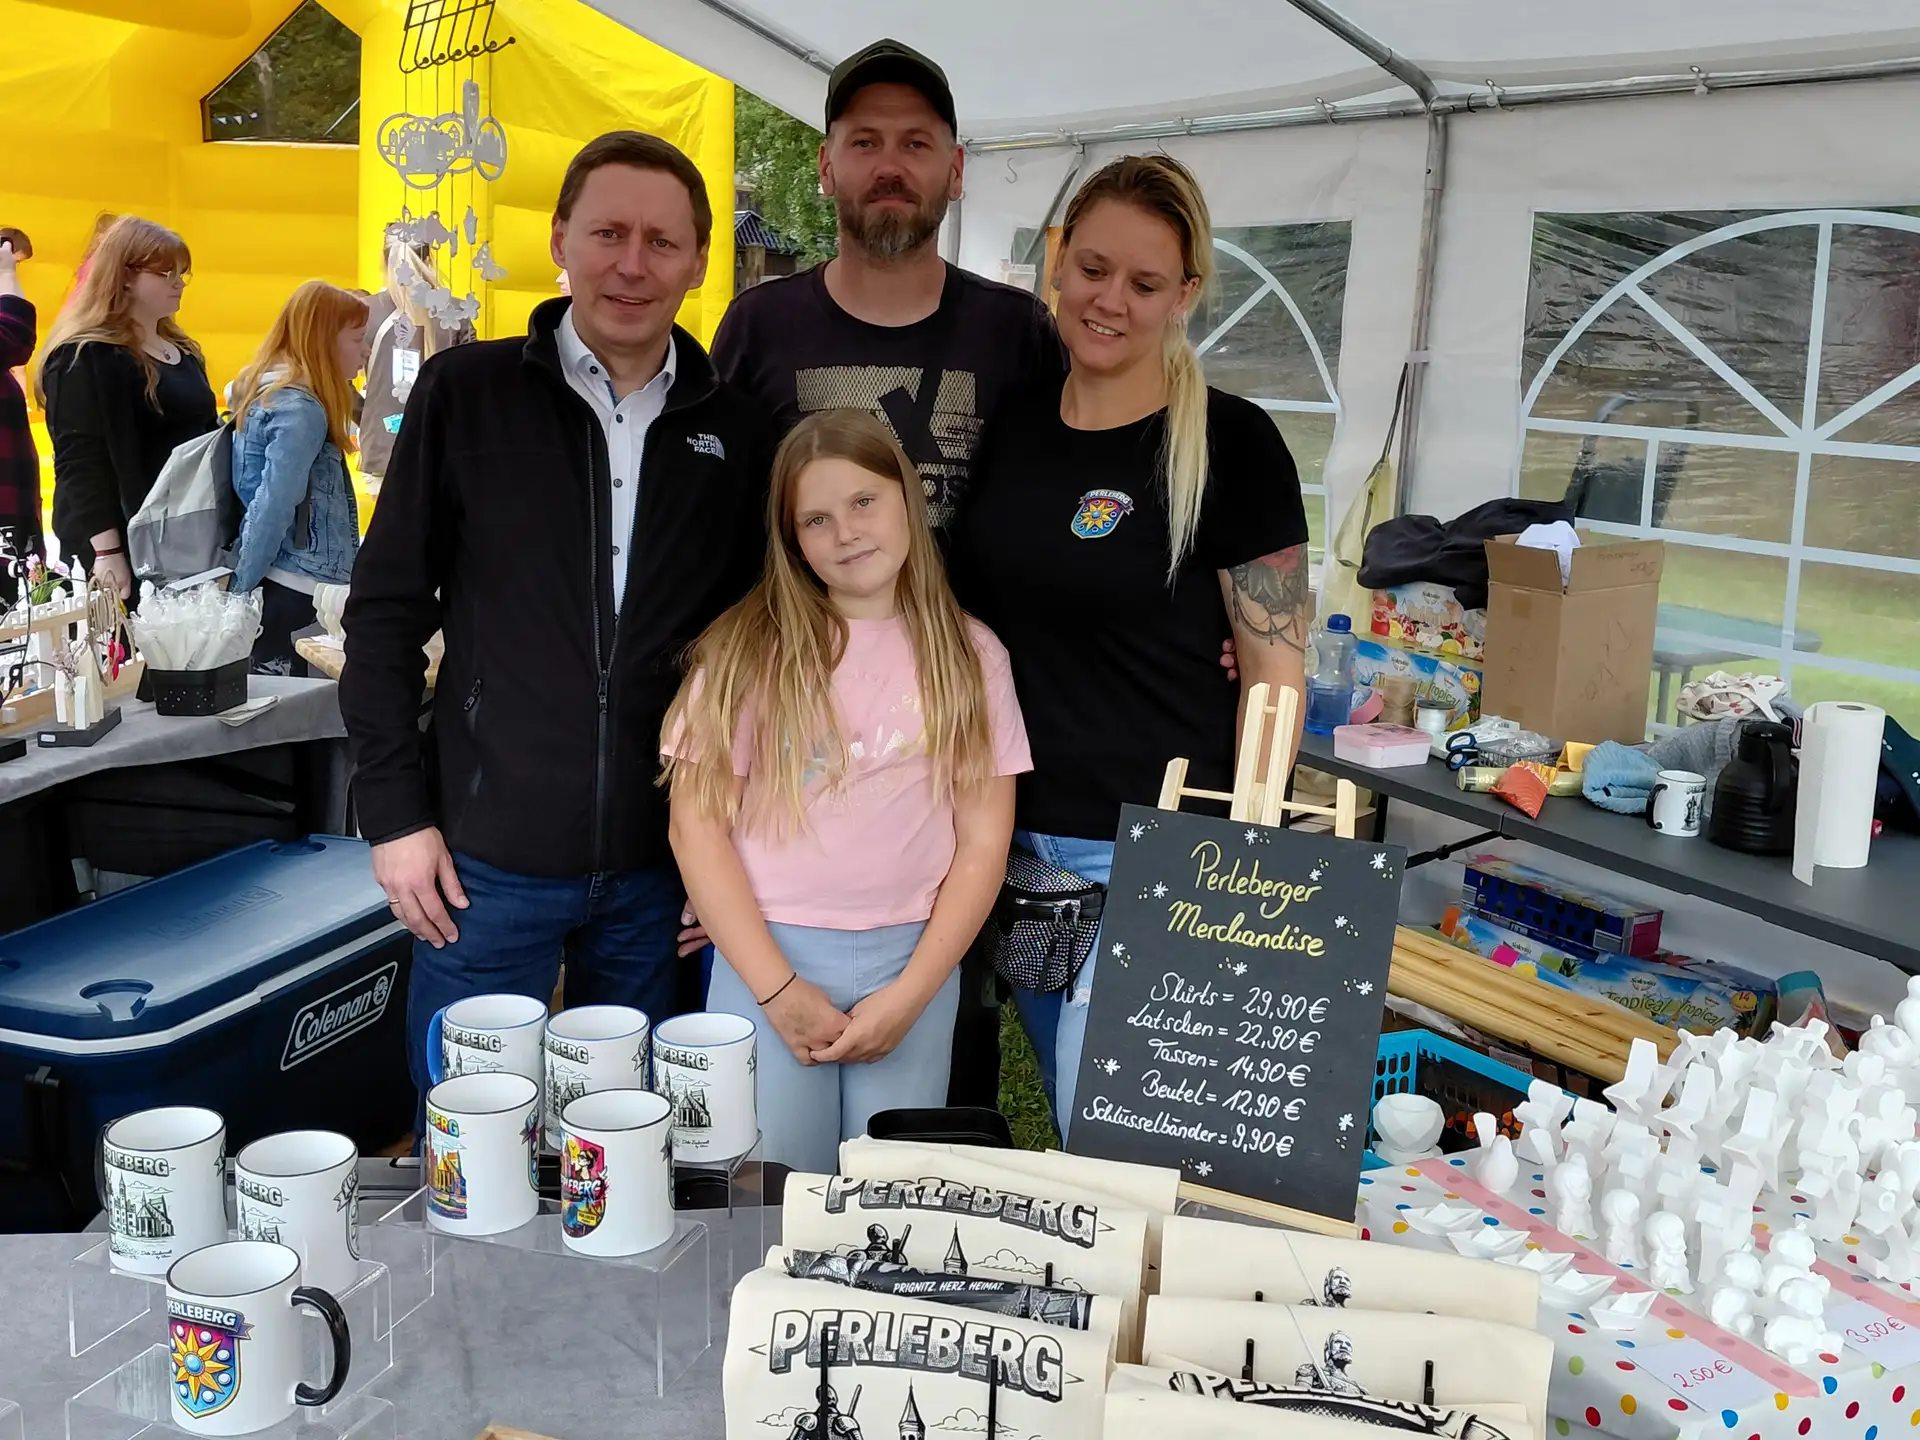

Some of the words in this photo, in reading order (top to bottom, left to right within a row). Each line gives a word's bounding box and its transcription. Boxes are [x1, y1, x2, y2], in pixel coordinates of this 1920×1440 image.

[686, 436, 716, 447] NORTH
[694, 446, 716, 454] FACE
[697, 433, 716, 441] THE
[1088, 490, 1130, 505] PERLEBERG
[1190, 840, 1323, 919] Perleberger
[1167, 900, 1326, 957] Merchandise
[294, 990, 373, 1049] Coleman
[443, 1022, 502, 1053] RLEBERG
[825, 1175, 1099, 1249] PERLEBERG
[892, 1281, 937, 1294] PRIGNITZ.
[939, 1280, 966, 1292] HERZ.
[968, 1281, 1005, 1292] HEIMAT.
[166, 1298, 238, 1327] PERLEBERG
[768, 1308, 1065, 1404] PERLEBERG
